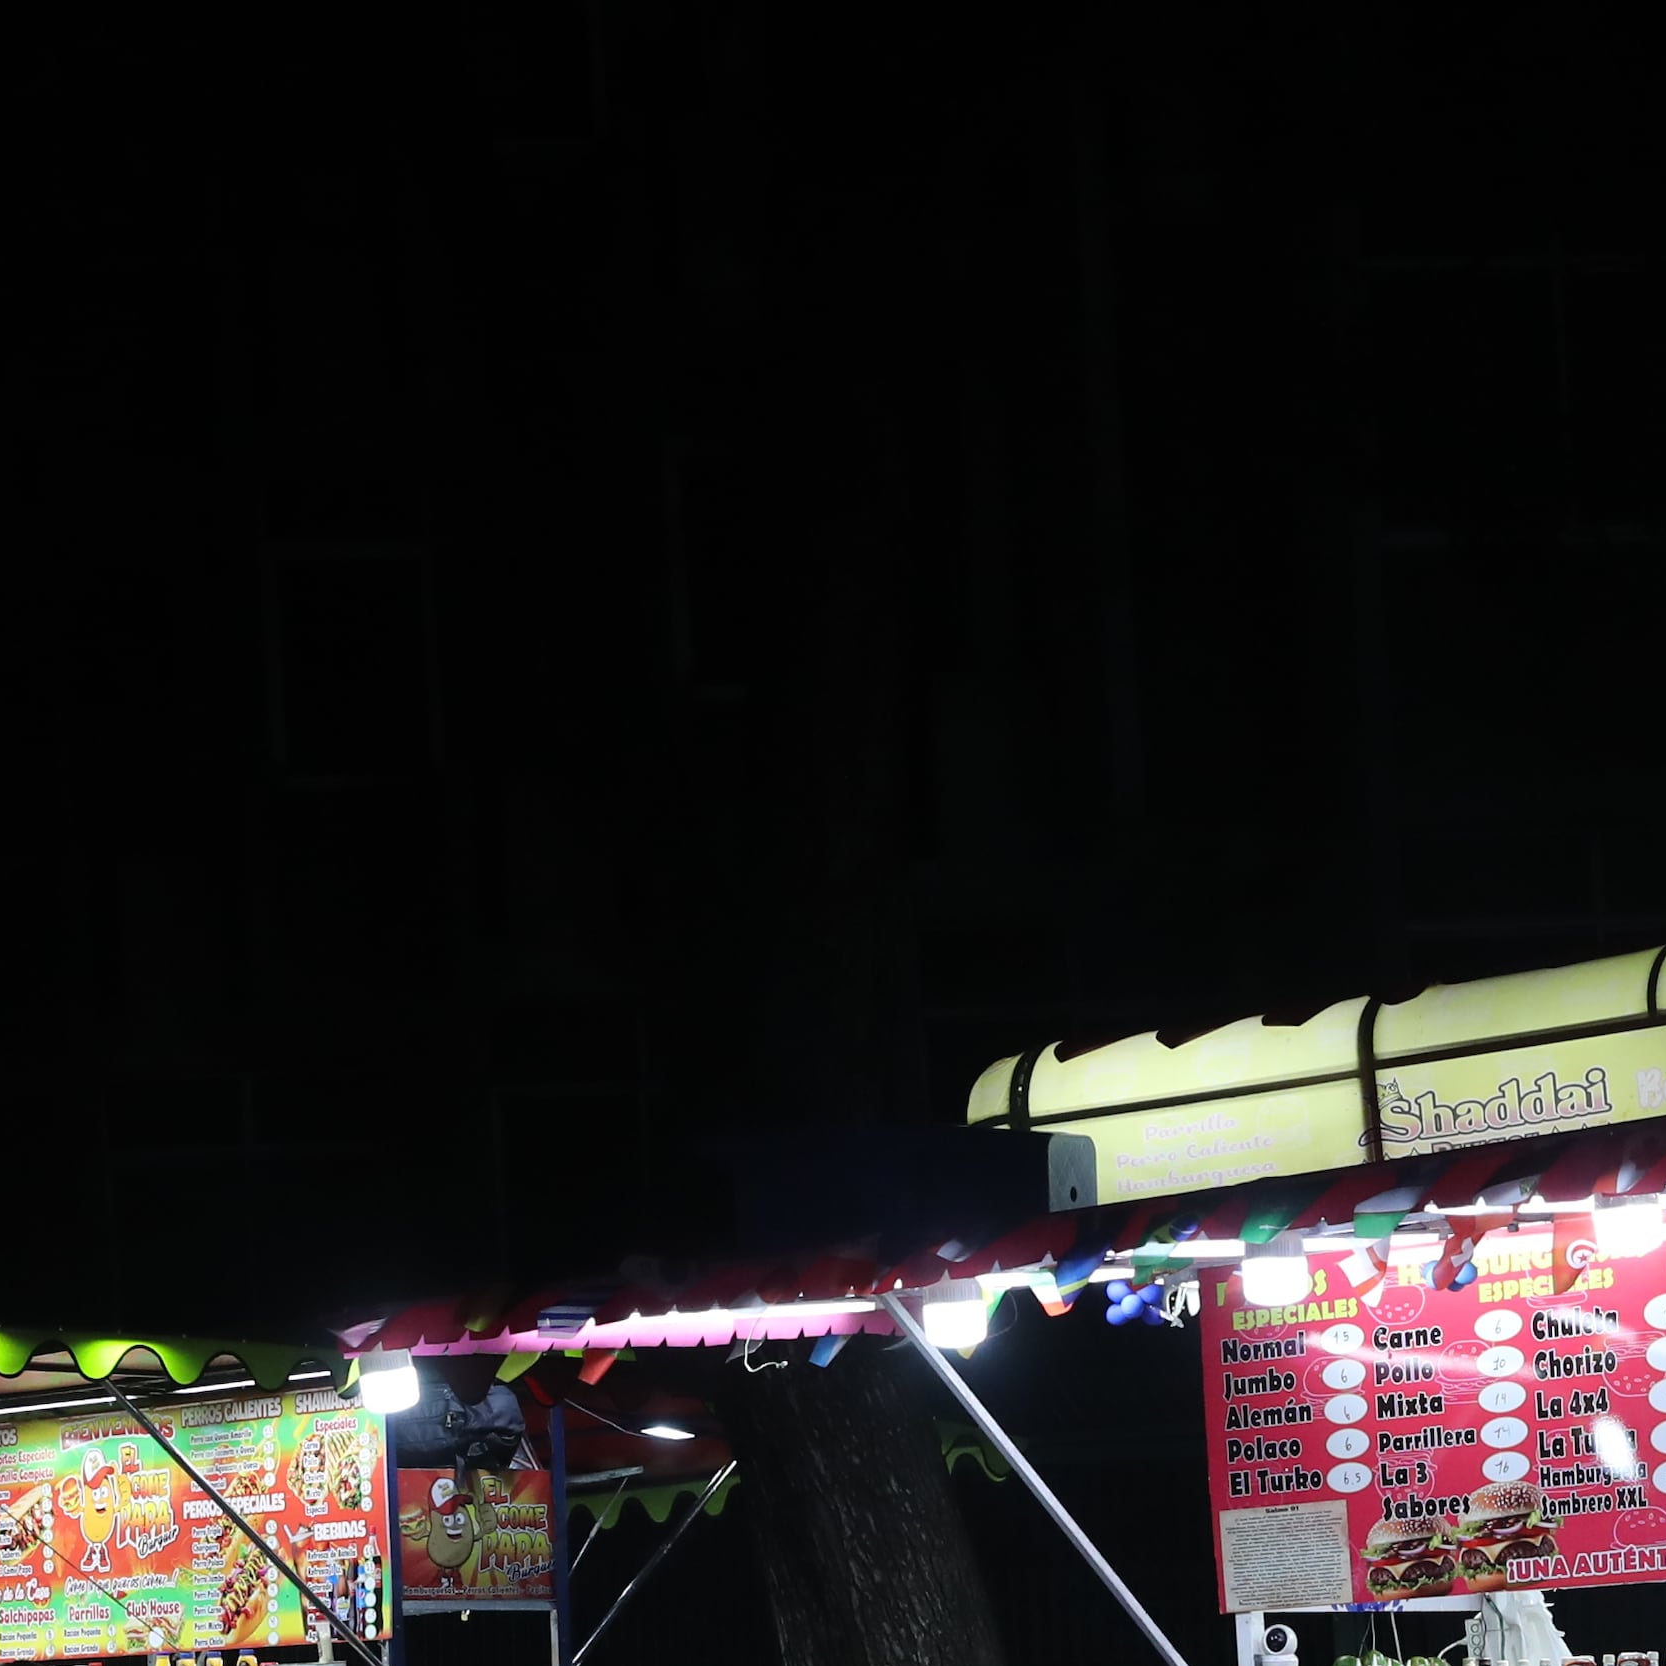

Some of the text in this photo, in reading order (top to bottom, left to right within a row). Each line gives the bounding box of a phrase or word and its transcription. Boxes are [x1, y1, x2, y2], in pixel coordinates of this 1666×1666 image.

[1358, 1067, 1613, 1146] Shaddai
[1232, 1298, 1359, 1331] ESPECIALES
[1532, 1306, 1619, 1341] Chuleta
[1221, 1331, 1306, 1364] Normal
[1373, 1325, 1443, 1351] Carne
[1374, 1357, 1434, 1387] Pollo
[1534, 1347, 1617, 1381] Chorizo
[1222, 1369, 1295, 1400] Jumbo
[181, 1397, 282, 1428] PERROS CALIENTES
[1225, 1399, 1313, 1432] Alemán
[1376, 1392, 1444, 1420] Mixta
[1536, 1388, 1609, 1420] La 4x4
[315, 1417, 357, 1434] Especiales
[1377, 1426, 1476, 1454] Parrillera
[121, 1444, 140, 1473] EL
[1226, 1437, 1302, 1464] Polaco
[1229, 1464, 1324, 1498] El Turko
[1380, 1462, 1429, 1488] La 3
[481, 1476, 509, 1505] EL
[1541, 1486, 1648, 1518] Sombrero XXL
[182, 1499, 223, 1520] PERROS
[496, 1504, 549, 1532] COME
[1383, 1494, 1472, 1521] Sabores
[313, 1520, 367, 1542] BEBIDAS
[480, 1528, 553, 1573] PAPA
[1506, 1556, 1571, 1584] ¡UNA
[69, 1603, 111, 1622] Parrillas
[149, 1600, 181, 1615] House
